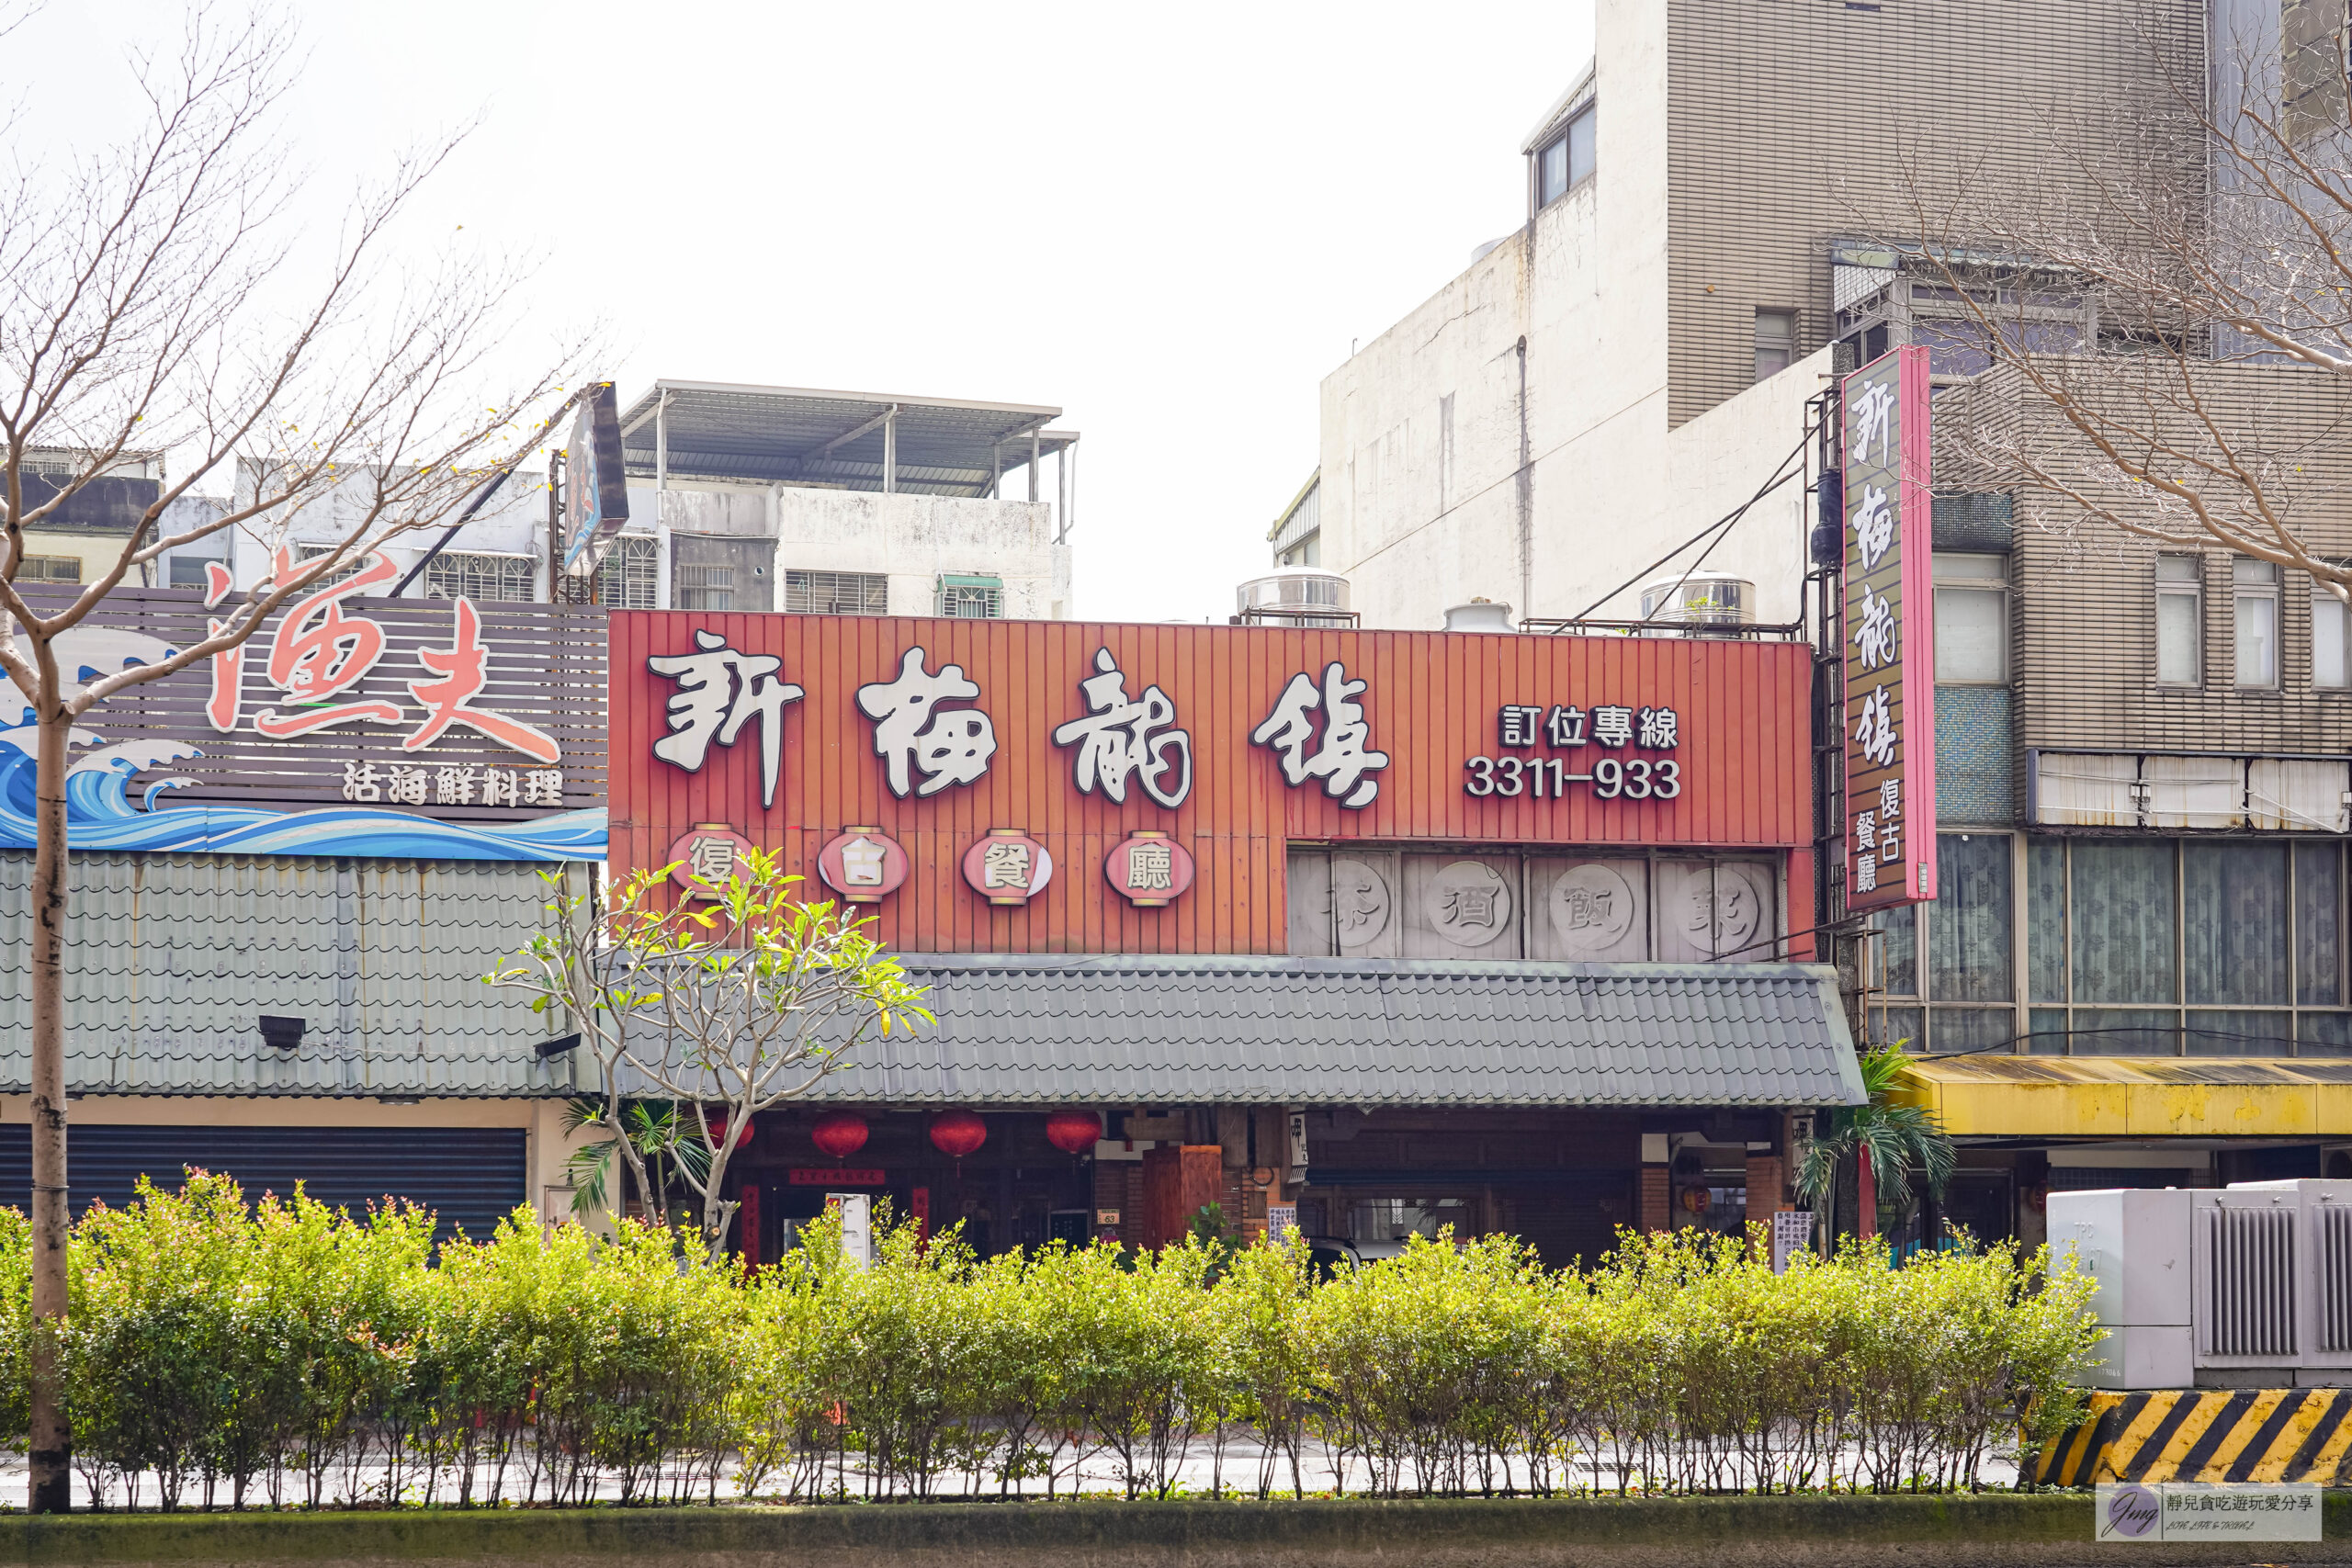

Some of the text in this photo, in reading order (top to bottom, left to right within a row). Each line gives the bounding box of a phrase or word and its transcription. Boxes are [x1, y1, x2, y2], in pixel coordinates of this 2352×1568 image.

[1851, 378, 1898, 767] 新梅龍鎮
[203, 542, 562, 763] 漁夫
[646, 628, 1390, 809] 新梅龍鎮
[1501, 705, 1679, 749] 訂位專線
[343, 763, 563, 807] 活海鮮料理
[1465, 755, 1681, 801] 3311-933
[1880, 778, 1901, 862] 復古
[1856, 810, 1876, 894] 餐廳
[1104, 1215, 1115, 1224] 63
